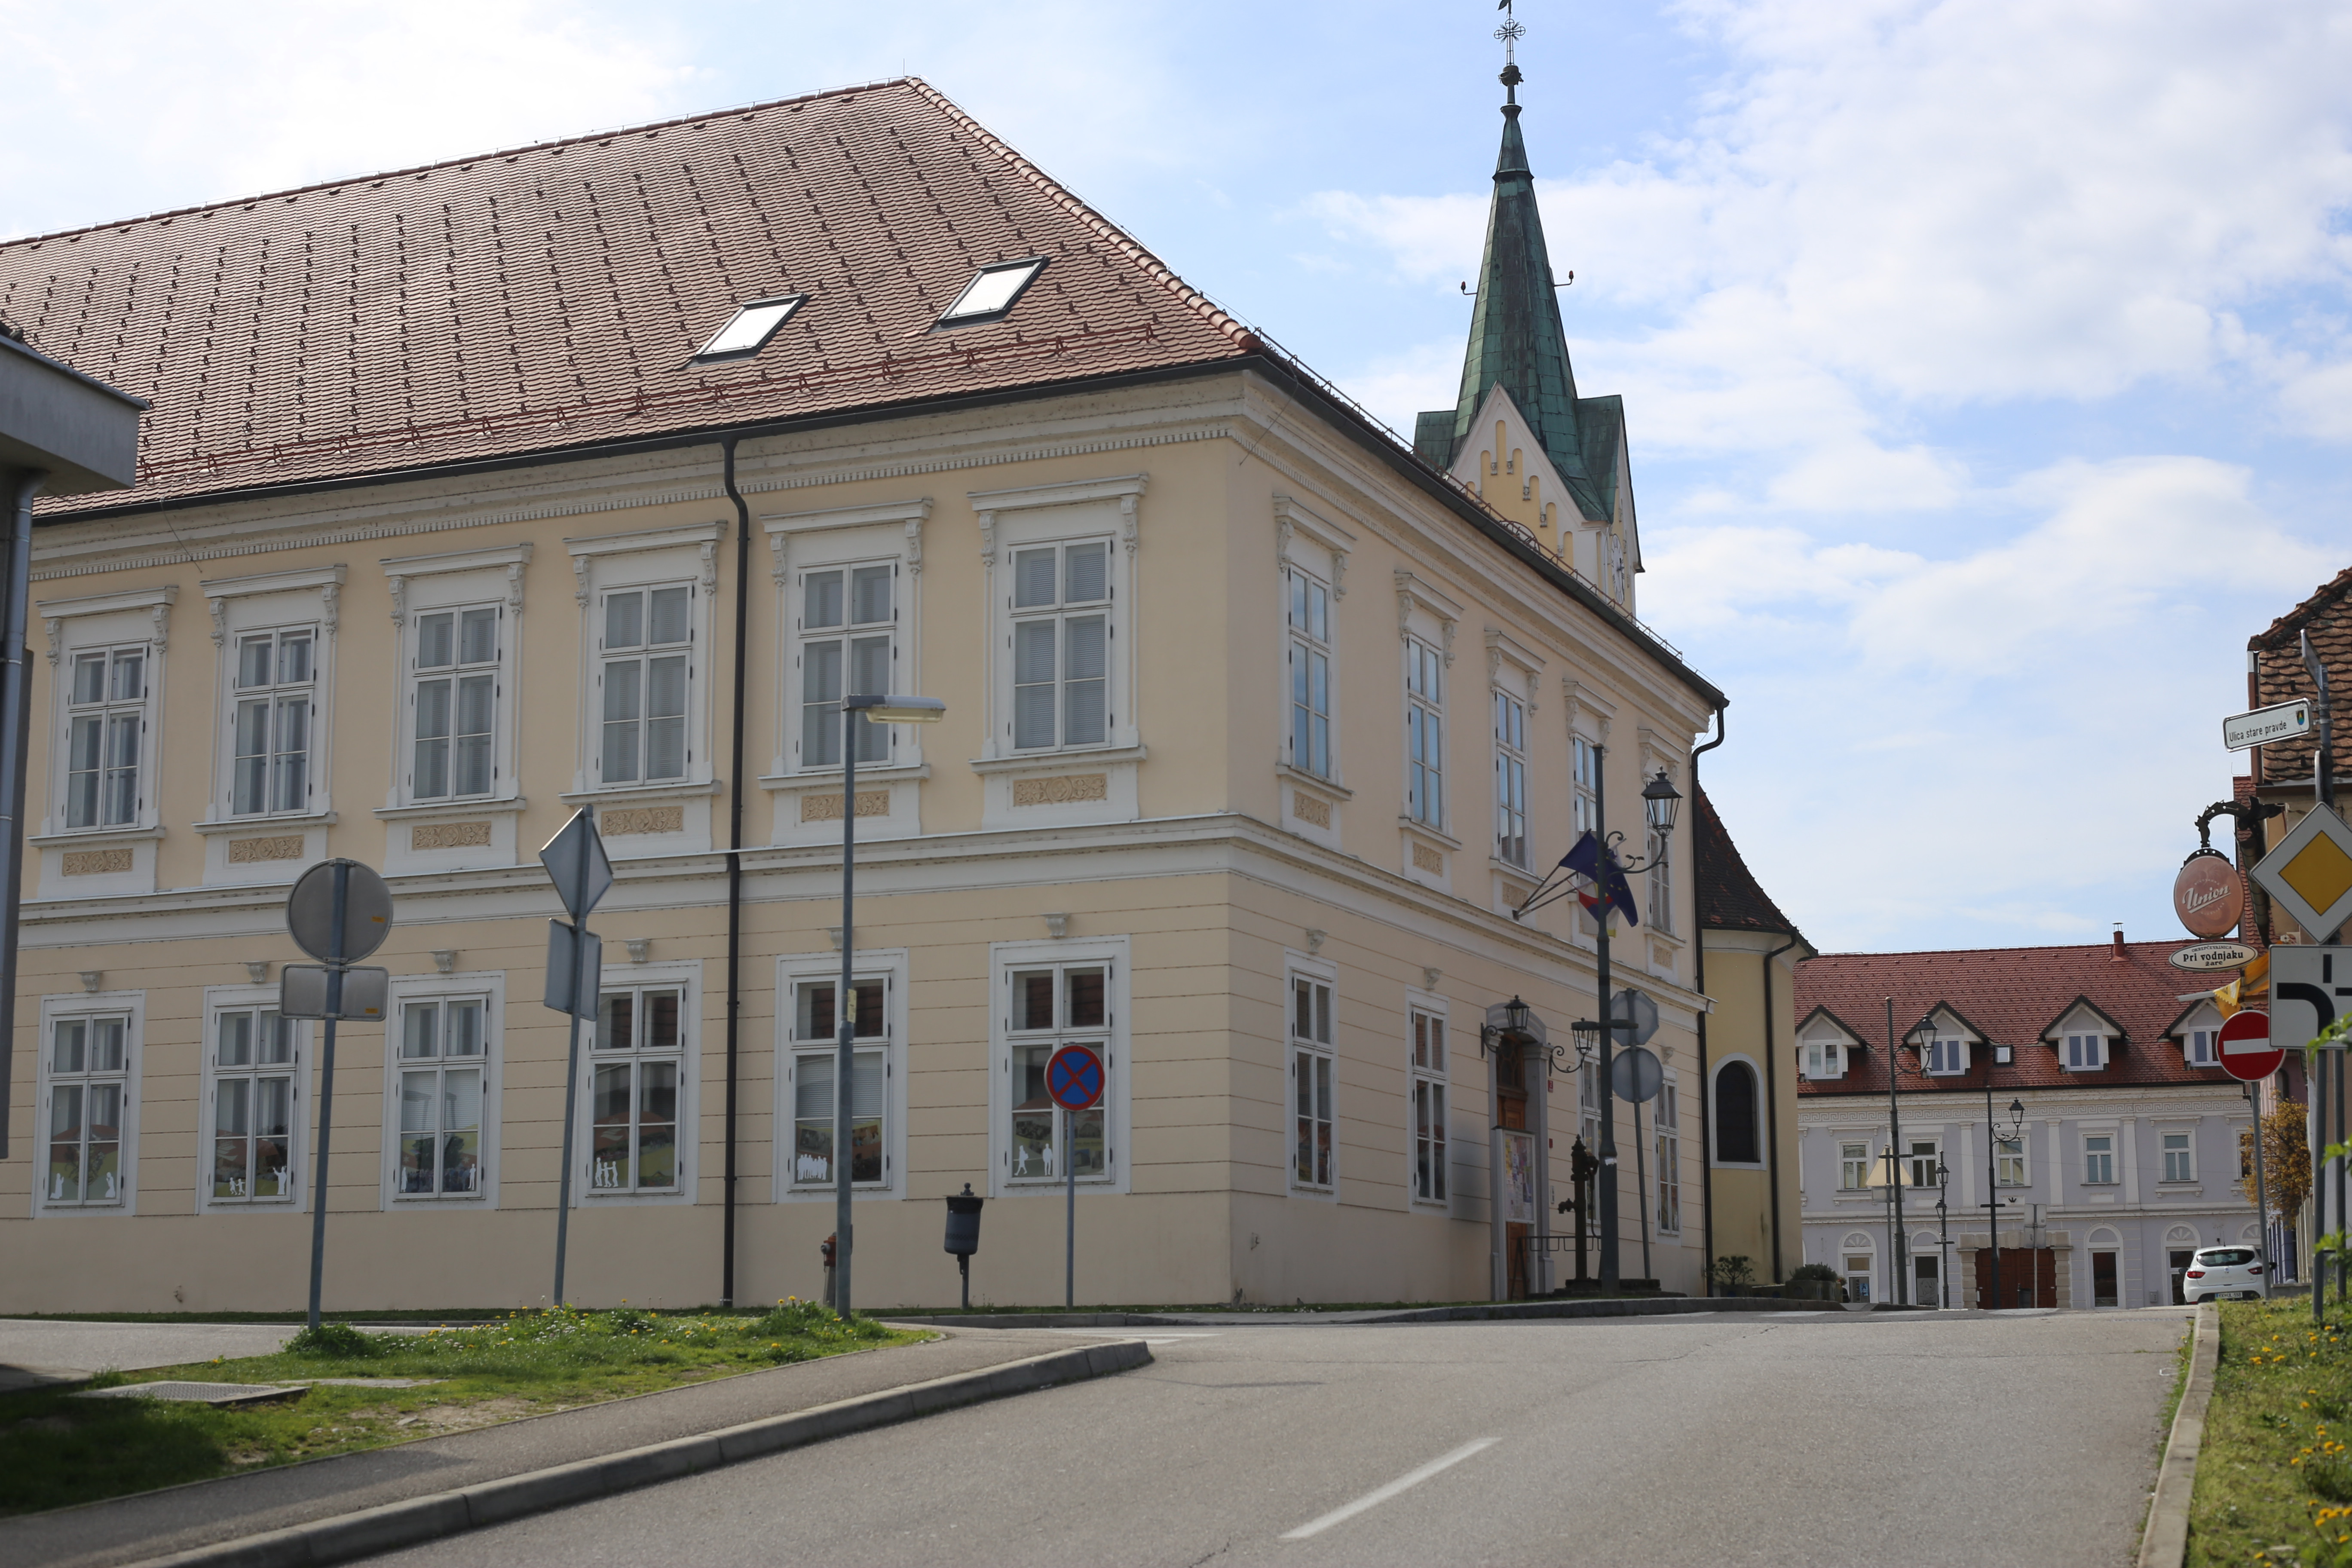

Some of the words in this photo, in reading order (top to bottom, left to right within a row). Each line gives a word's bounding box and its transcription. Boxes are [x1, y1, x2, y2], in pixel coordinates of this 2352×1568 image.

[2229, 732, 2244, 741] Ulica
[2246, 728, 2263, 738] stare
[2265, 720, 2287, 736] pravde
[2182, 885, 2230, 910] Union
[2183, 953, 2197, 962] Pri
[2200, 950, 2244, 961] vodnjaku
